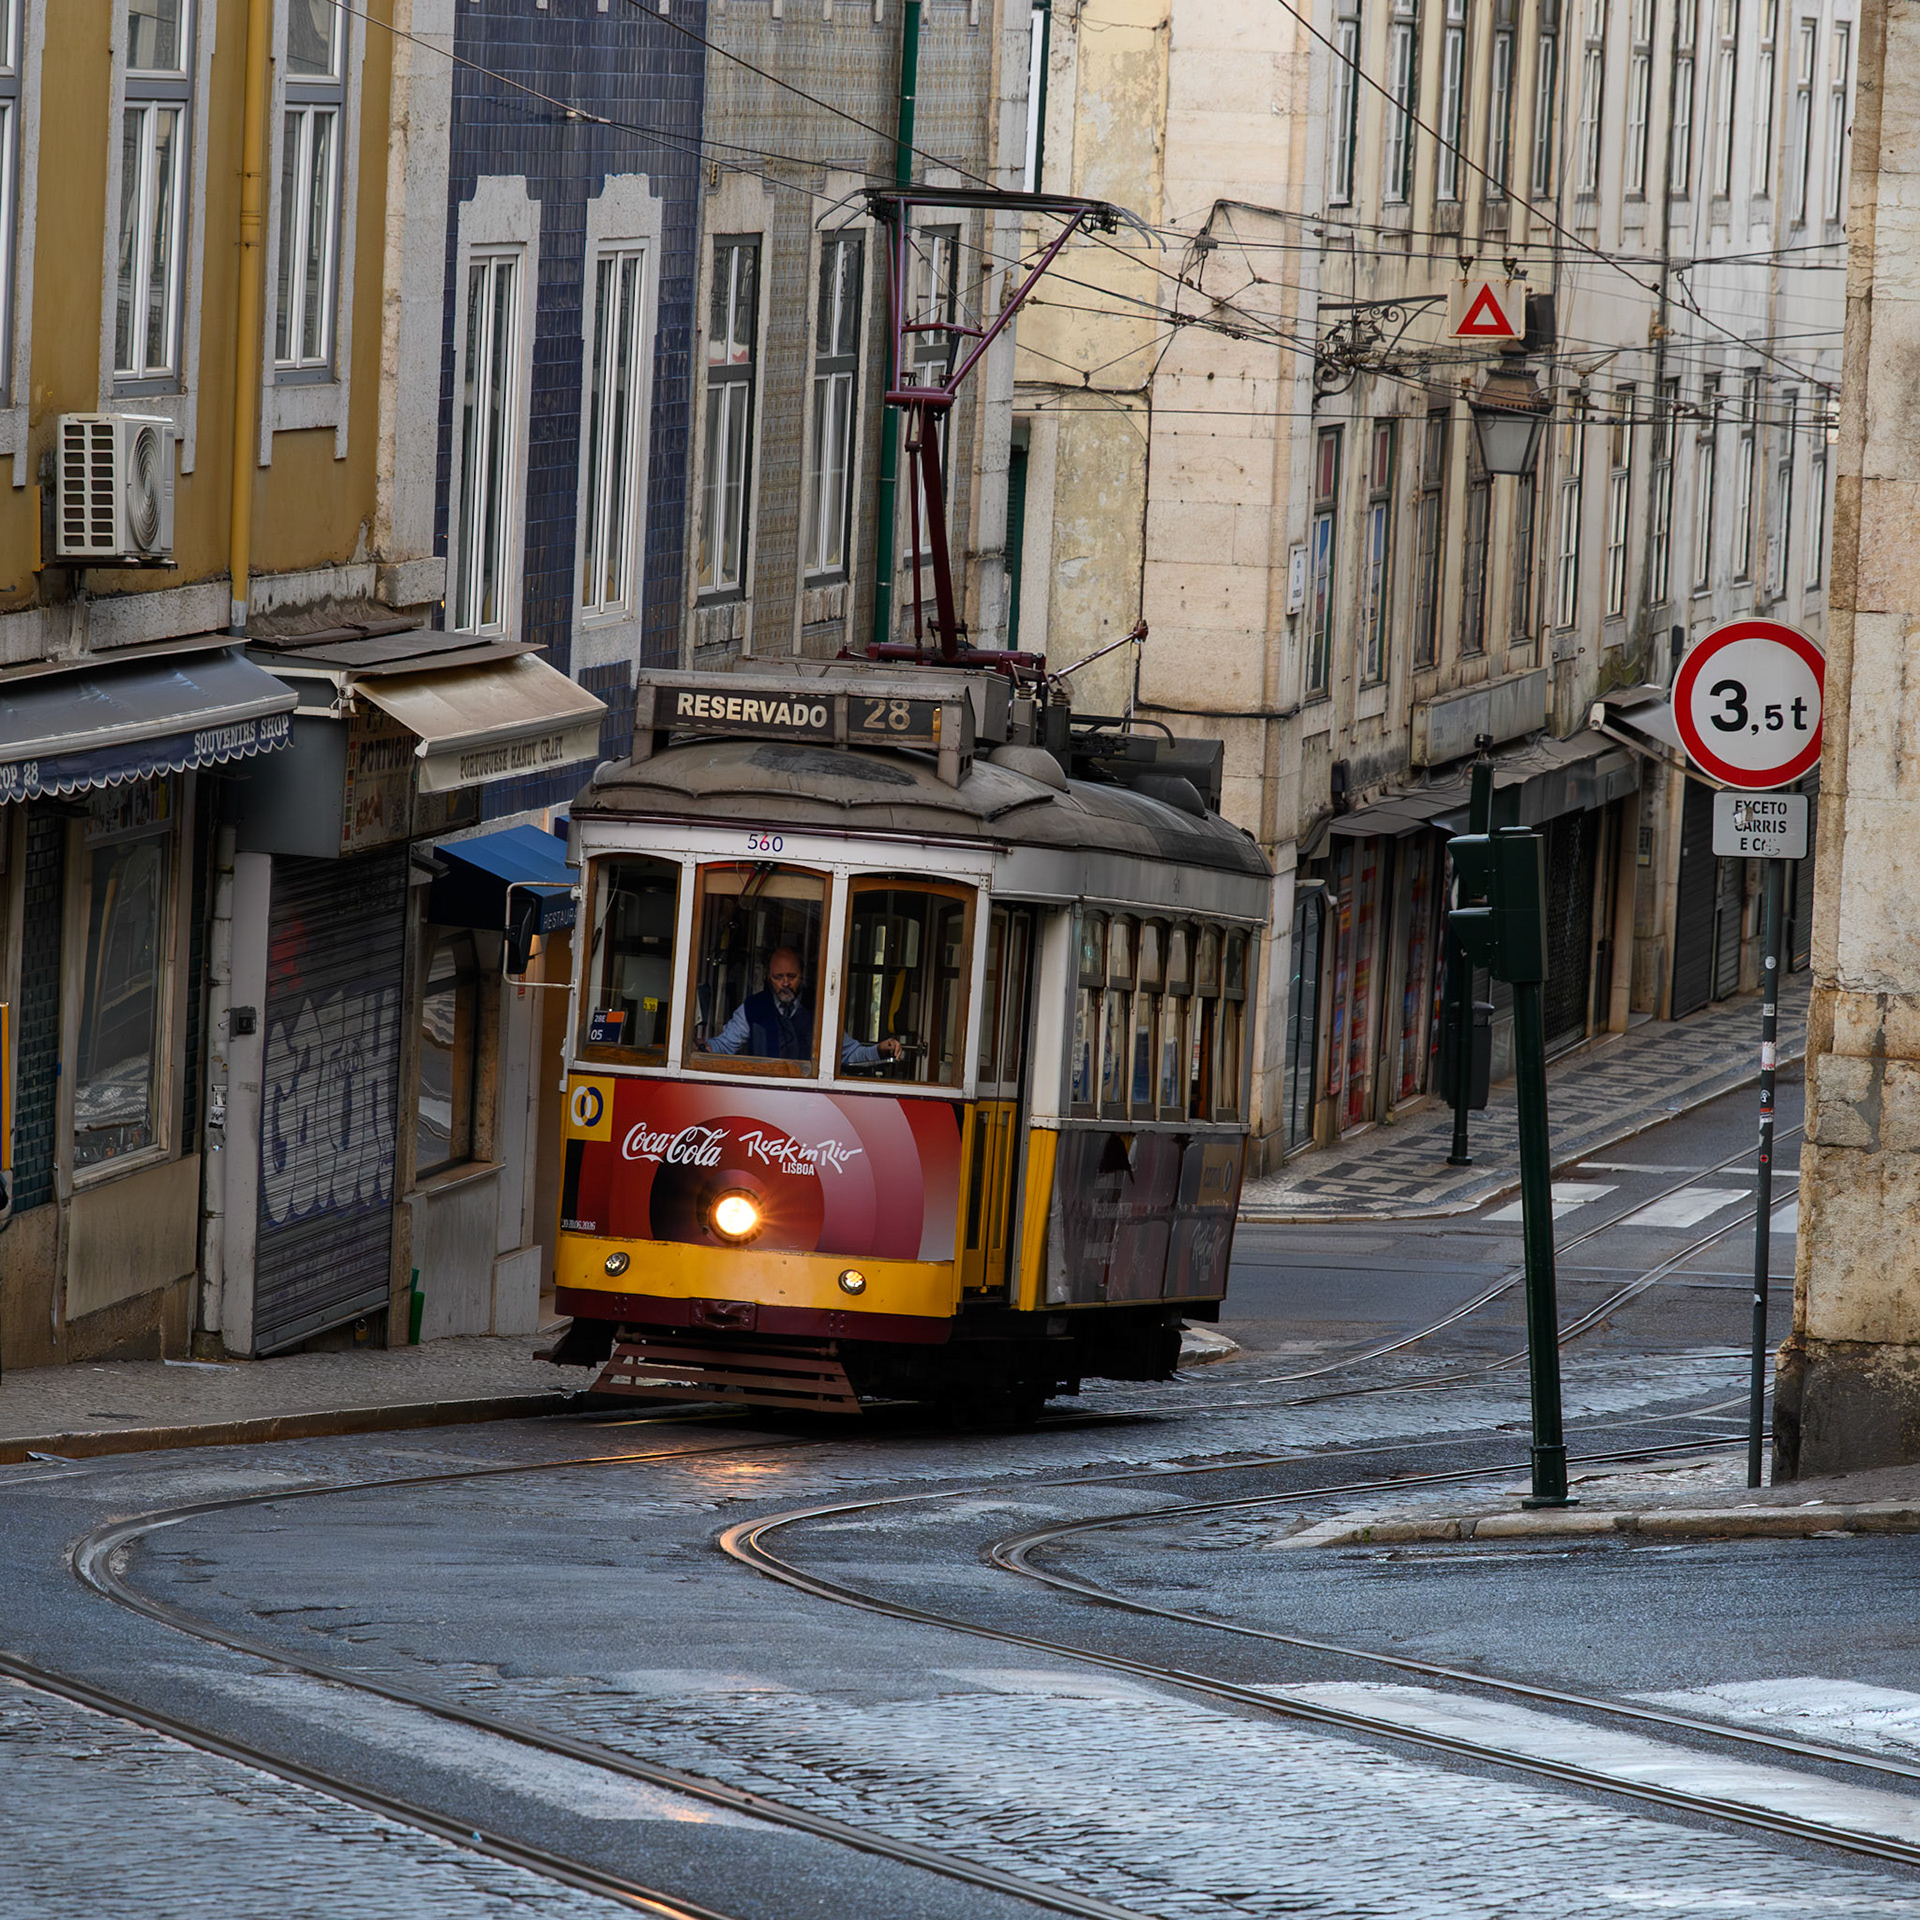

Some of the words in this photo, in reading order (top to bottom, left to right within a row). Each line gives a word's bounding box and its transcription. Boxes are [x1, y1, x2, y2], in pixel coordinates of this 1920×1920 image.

[677, 692, 828, 728] RESERVADO
[863, 699, 911, 730] 28
[194, 721, 256, 755] SOUVENIRS
[260, 714, 290, 740] SHOP
[359, 733, 417, 774] PORTUGU
[460, 747, 508, 779] PORTUGUESE
[511, 741, 537, 769] HANDY
[540, 735, 563, 763] CRAFT
[23, 761, 39, 786] 28
[747, 833, 784, 852] 560
[544, 907, 577, 929] RESTAUR
[590, 1029, 603, 1040] 05
[621, 1121, 731, 1168] Coca-Cola
[738, 1130, 799, 1165] Rock
[816, 1139, 863, 1174] Rio
[782, 1161, 815, 1175] LISBOA
